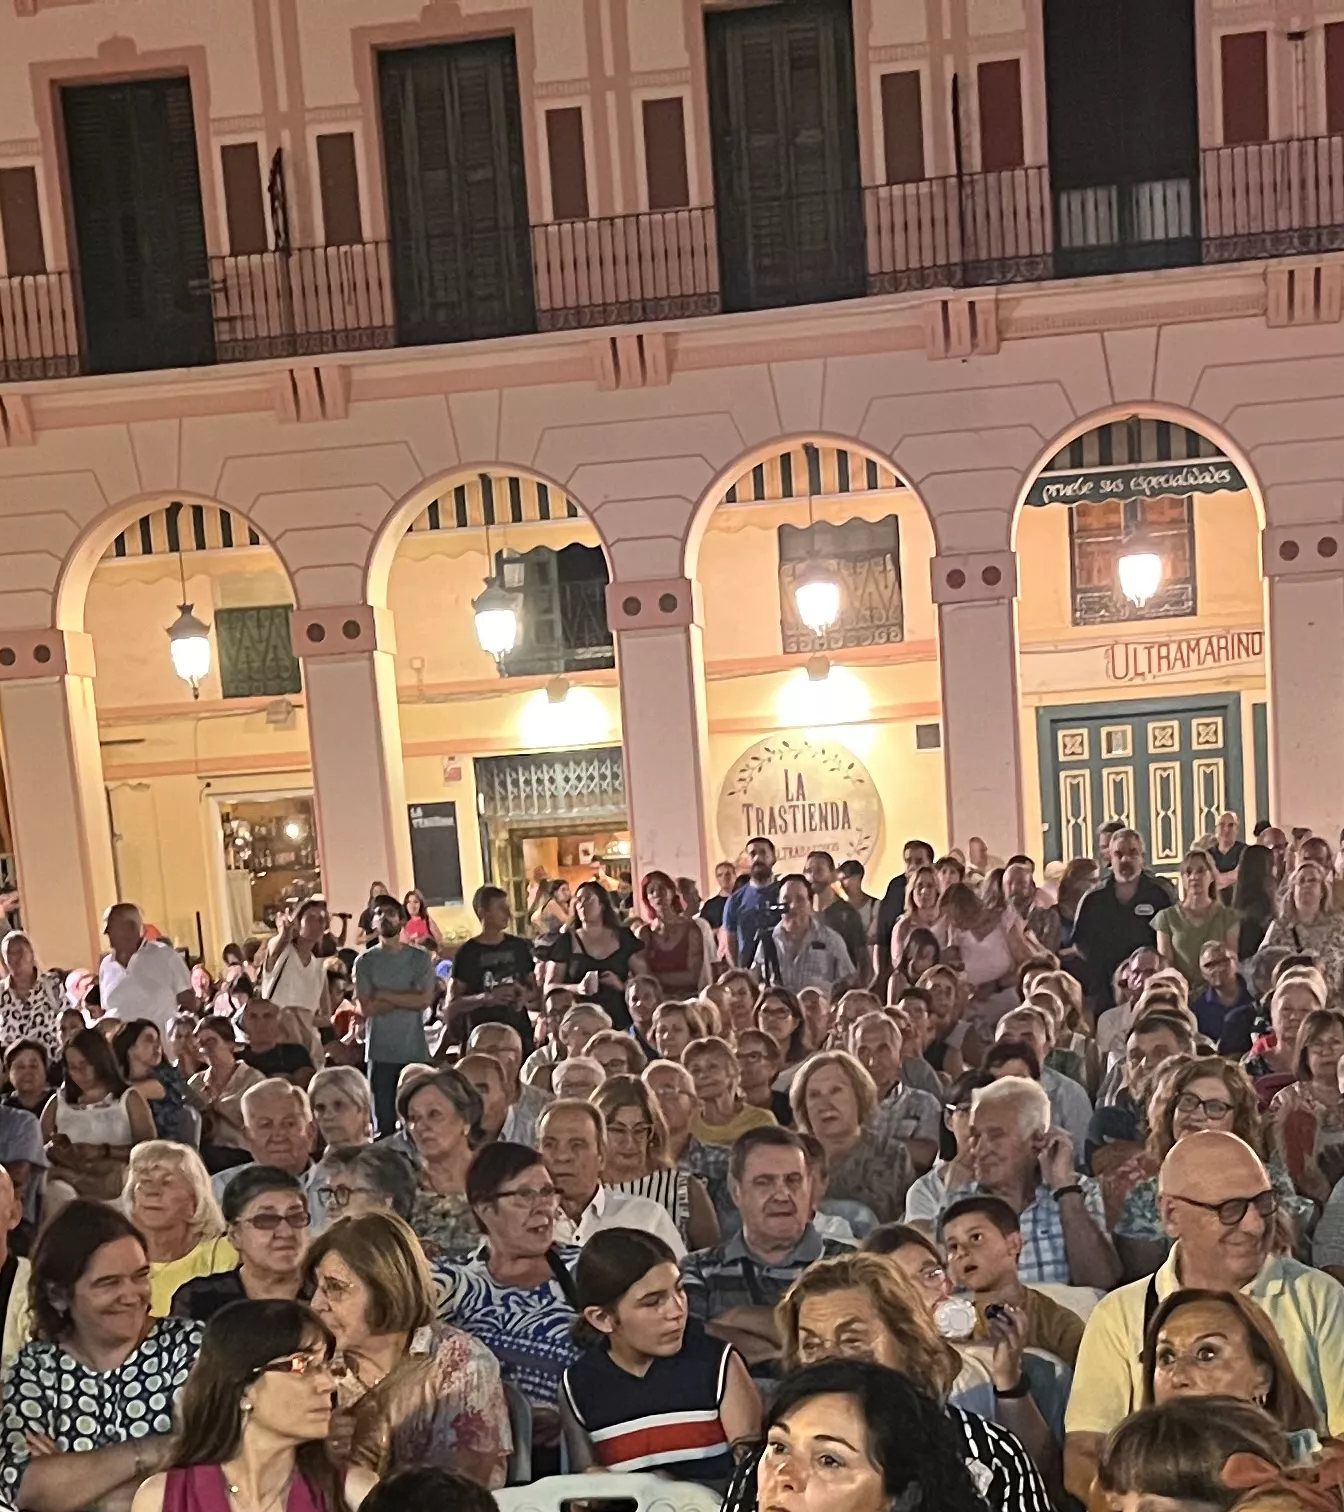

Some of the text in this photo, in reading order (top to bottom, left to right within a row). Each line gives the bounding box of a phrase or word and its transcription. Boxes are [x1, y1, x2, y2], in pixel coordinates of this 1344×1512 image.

[1043, 465, 1232, 504] pruebe sus especialidades
[783, 768, 806, 802] LA
[741, 800, 852, 837] TRASTIENDA
